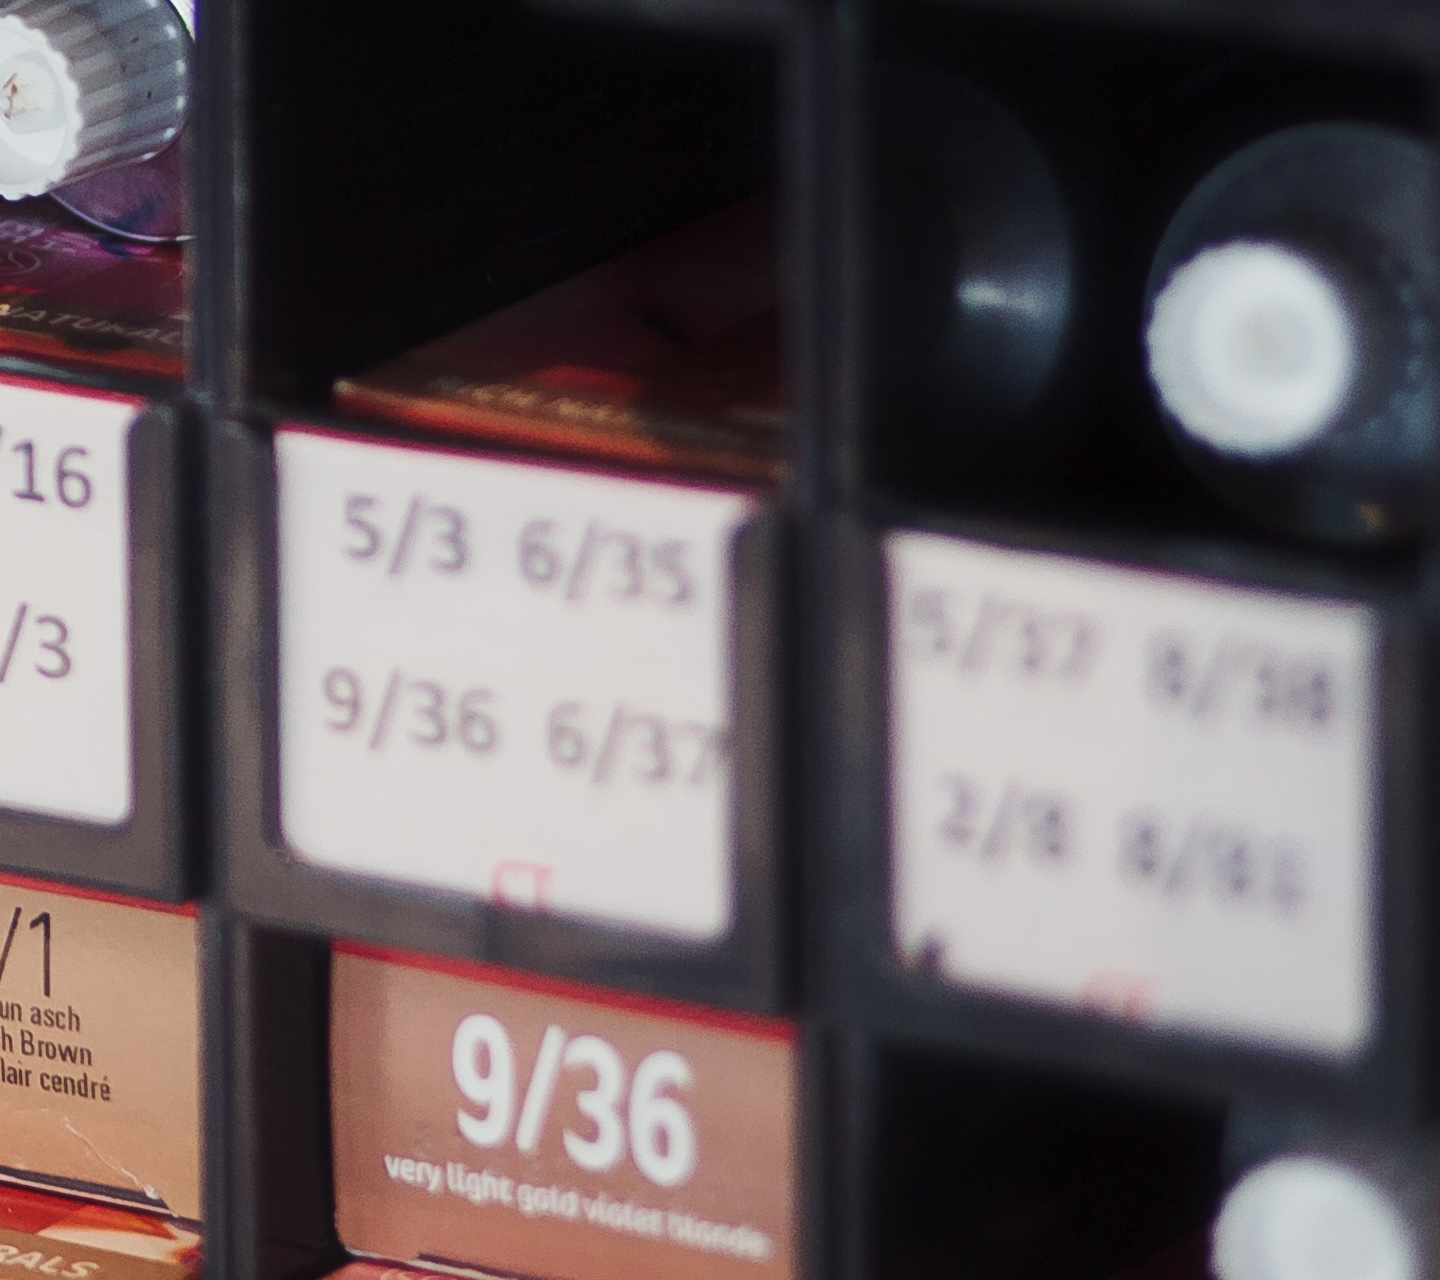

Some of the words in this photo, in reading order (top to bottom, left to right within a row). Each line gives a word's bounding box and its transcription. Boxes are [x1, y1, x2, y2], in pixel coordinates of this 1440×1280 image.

[342, 490, 472, 580] 5/3
[515, 515, 696, 610] 6/35
[320, 664, 502, 757] 9/36
[543, 698, 734, 790] 6/37
[29, 1000, 82, 1033] asch
[20, 1026, 94, 1067] Brown
[39, 1071, 112, 1103] cendré
[450, 1012, 698, 1189] 9/36
[383, 1153, 444, 1196] very
[445, 1160, 515, 1207] light
